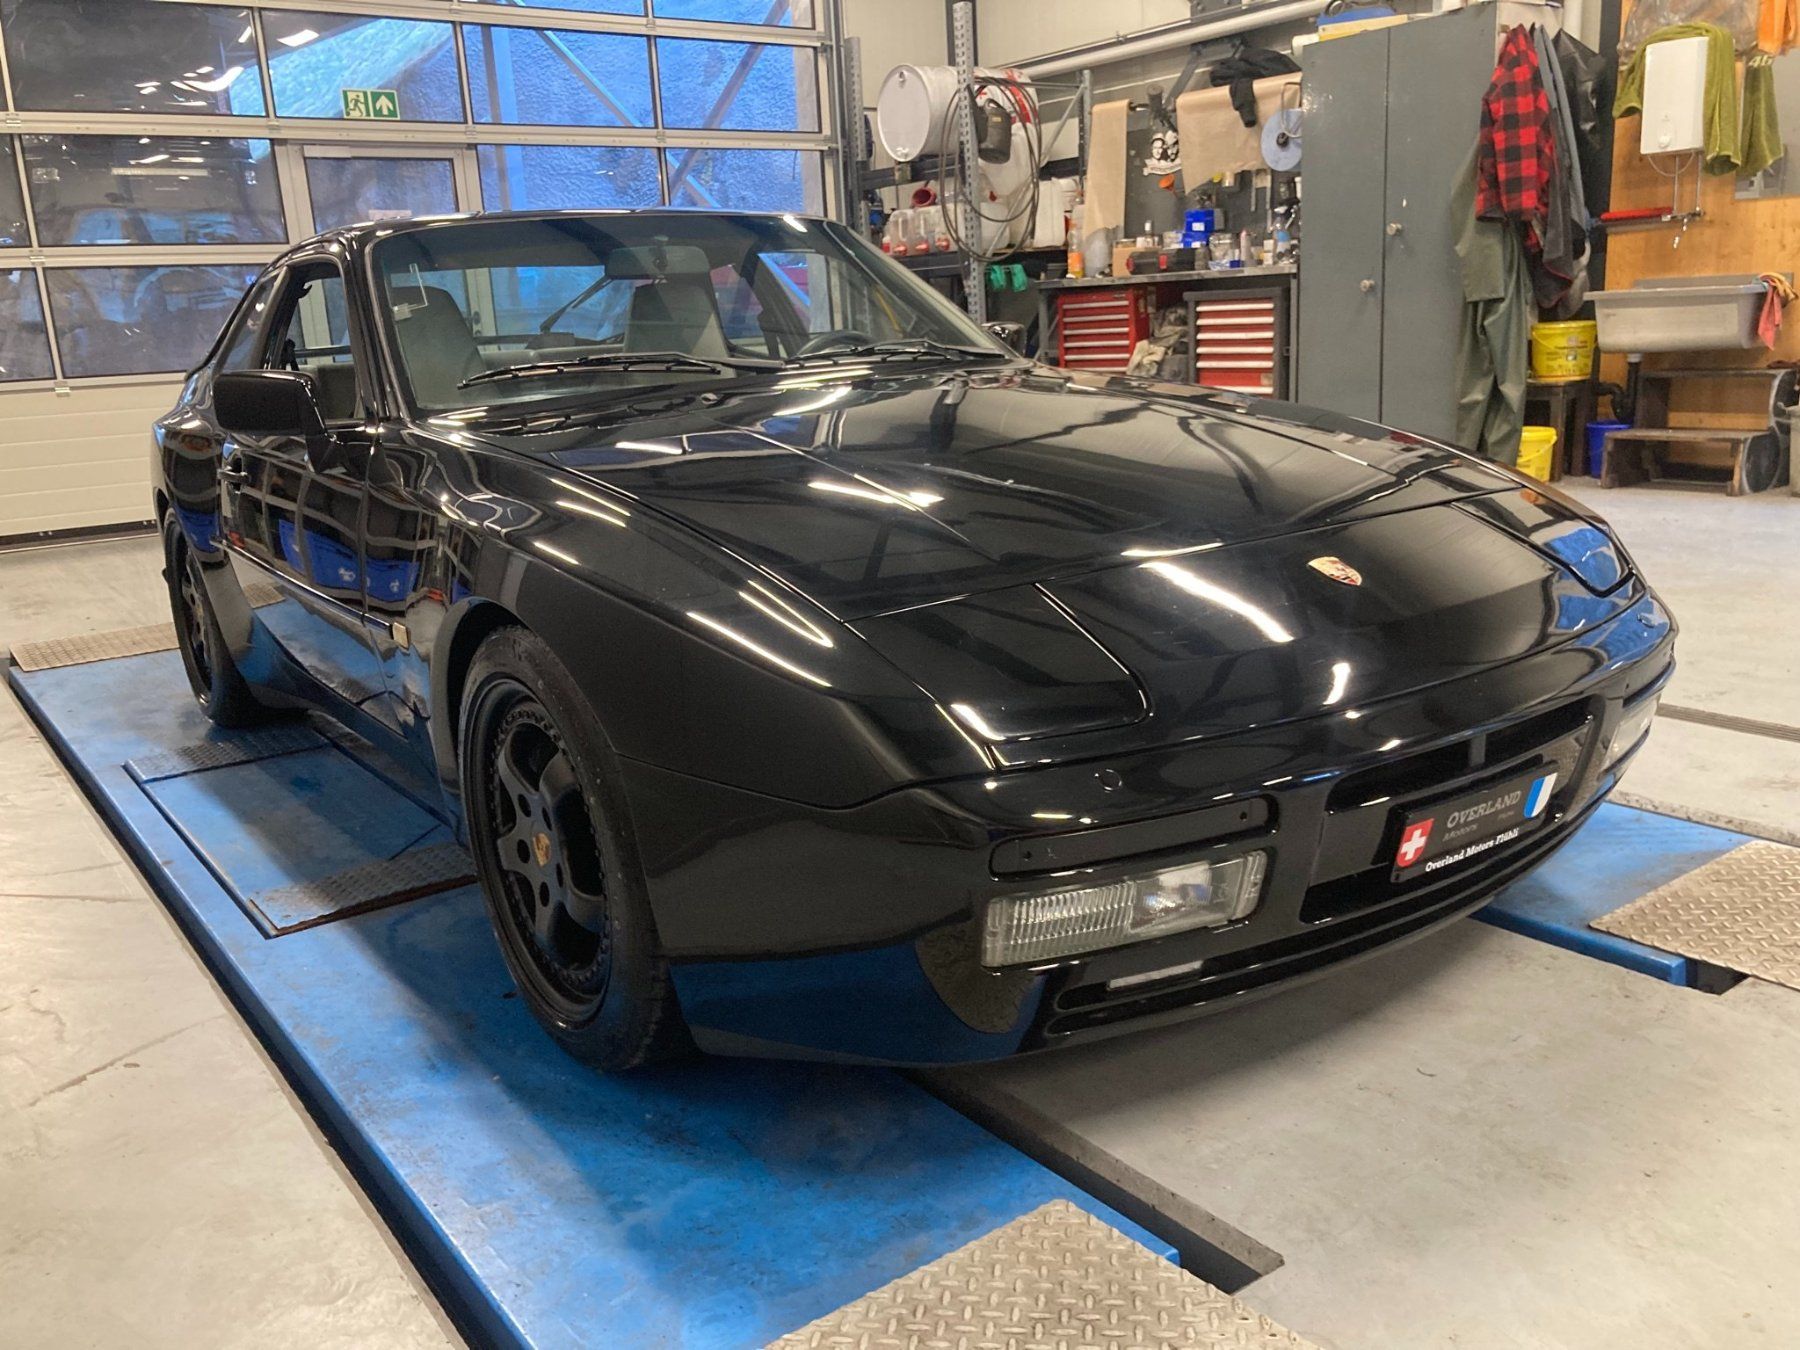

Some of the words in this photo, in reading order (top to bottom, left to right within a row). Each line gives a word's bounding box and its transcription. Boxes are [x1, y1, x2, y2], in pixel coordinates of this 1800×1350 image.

[1447, 790, 1522, 828] OVERLAND
[1425, 849, 1465, 872] Overland
[1465, 839, 1494, 856] Motors
